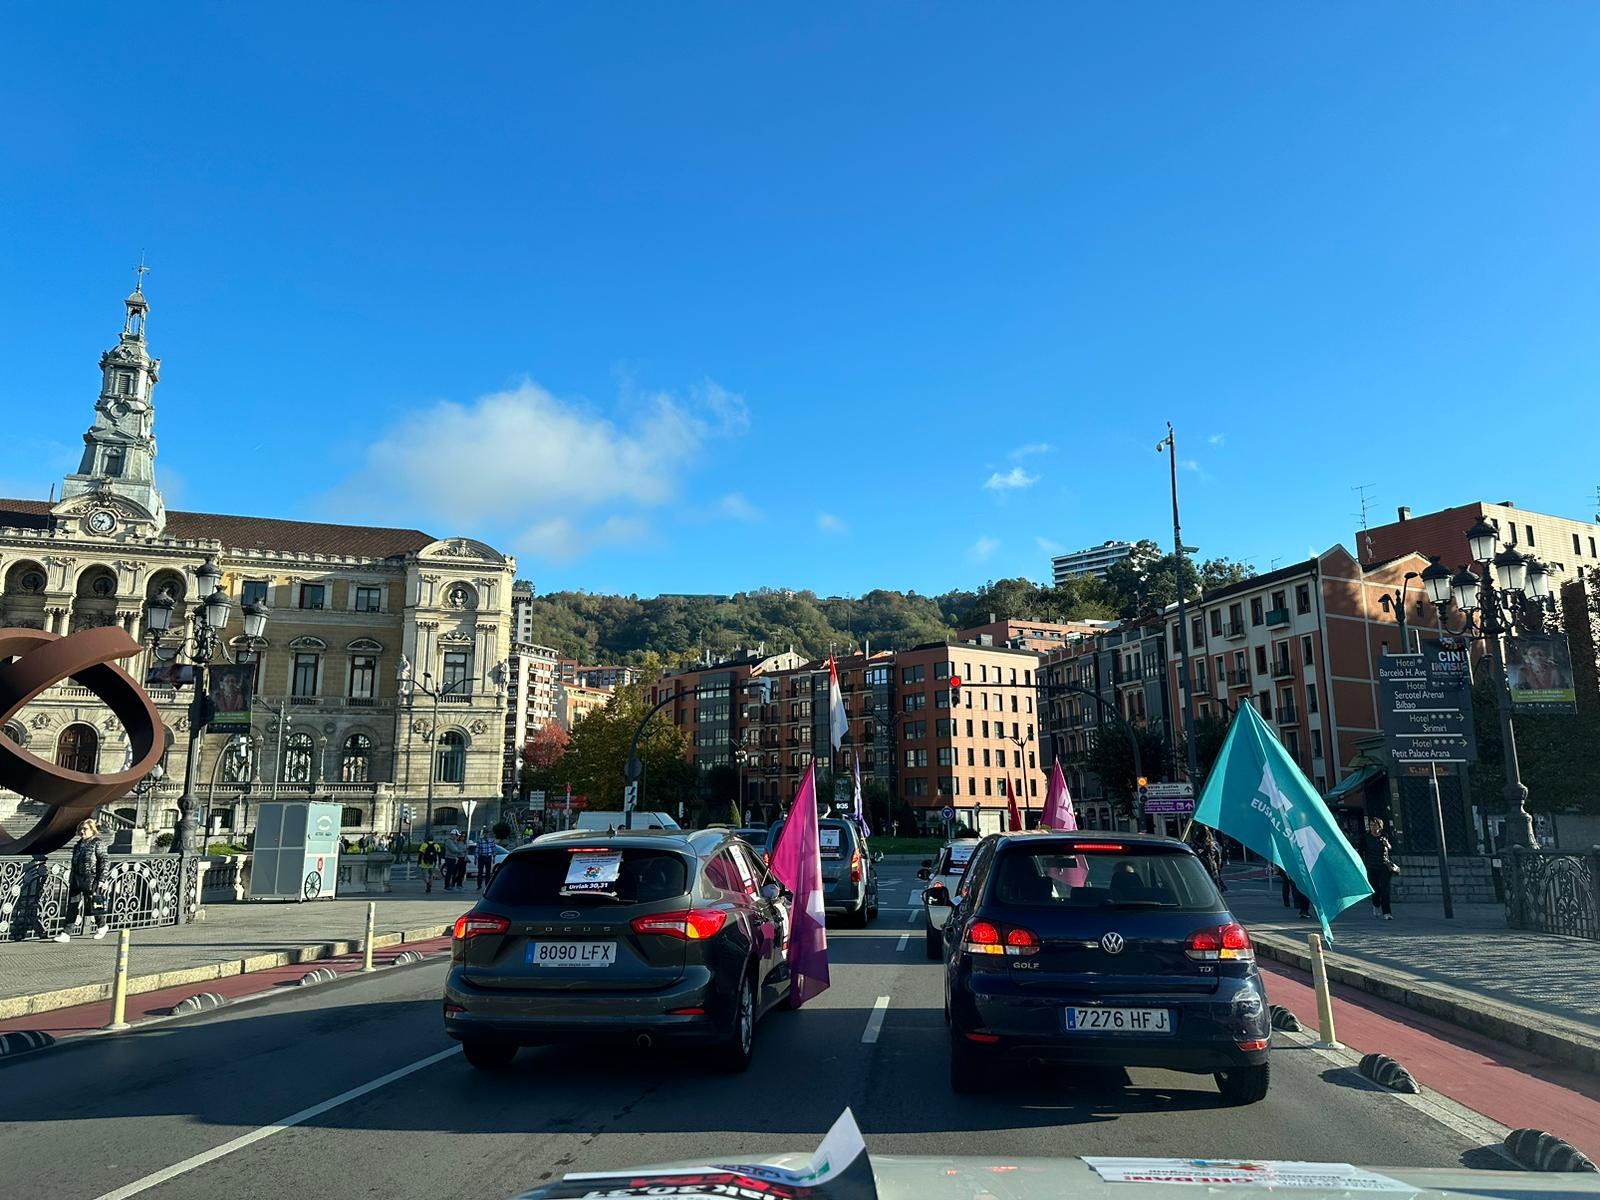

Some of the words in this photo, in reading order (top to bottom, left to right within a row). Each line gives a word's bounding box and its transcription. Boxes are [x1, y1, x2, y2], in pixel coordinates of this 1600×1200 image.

[1396, 658, 1415, 667] Hotel
[1407, 682, 1426, 690] Hotel
[1394, 691, 1421, 700] Sercotel
[1422, 690, 1444, 699] Arenal
[1395, 700, 1416, 709] Bilbao
[1409, 714, 1430, 722] Hotel
[1422, 724, 1447, 732] Sirimiri
[1412, 739, 1432, 747] Hotel
[1392, 749, 1408, 758] Petit
[1408, 749, 1429, 758] Palace
[1430, 749, 1450, 758] Arana
[540, 945, 577, 960] 8090
[582, 945, 610, 960] LFX
[1078, 1010, 1124, 1028] 7276
[1131, 1011, 1166, 1030] HFJ
